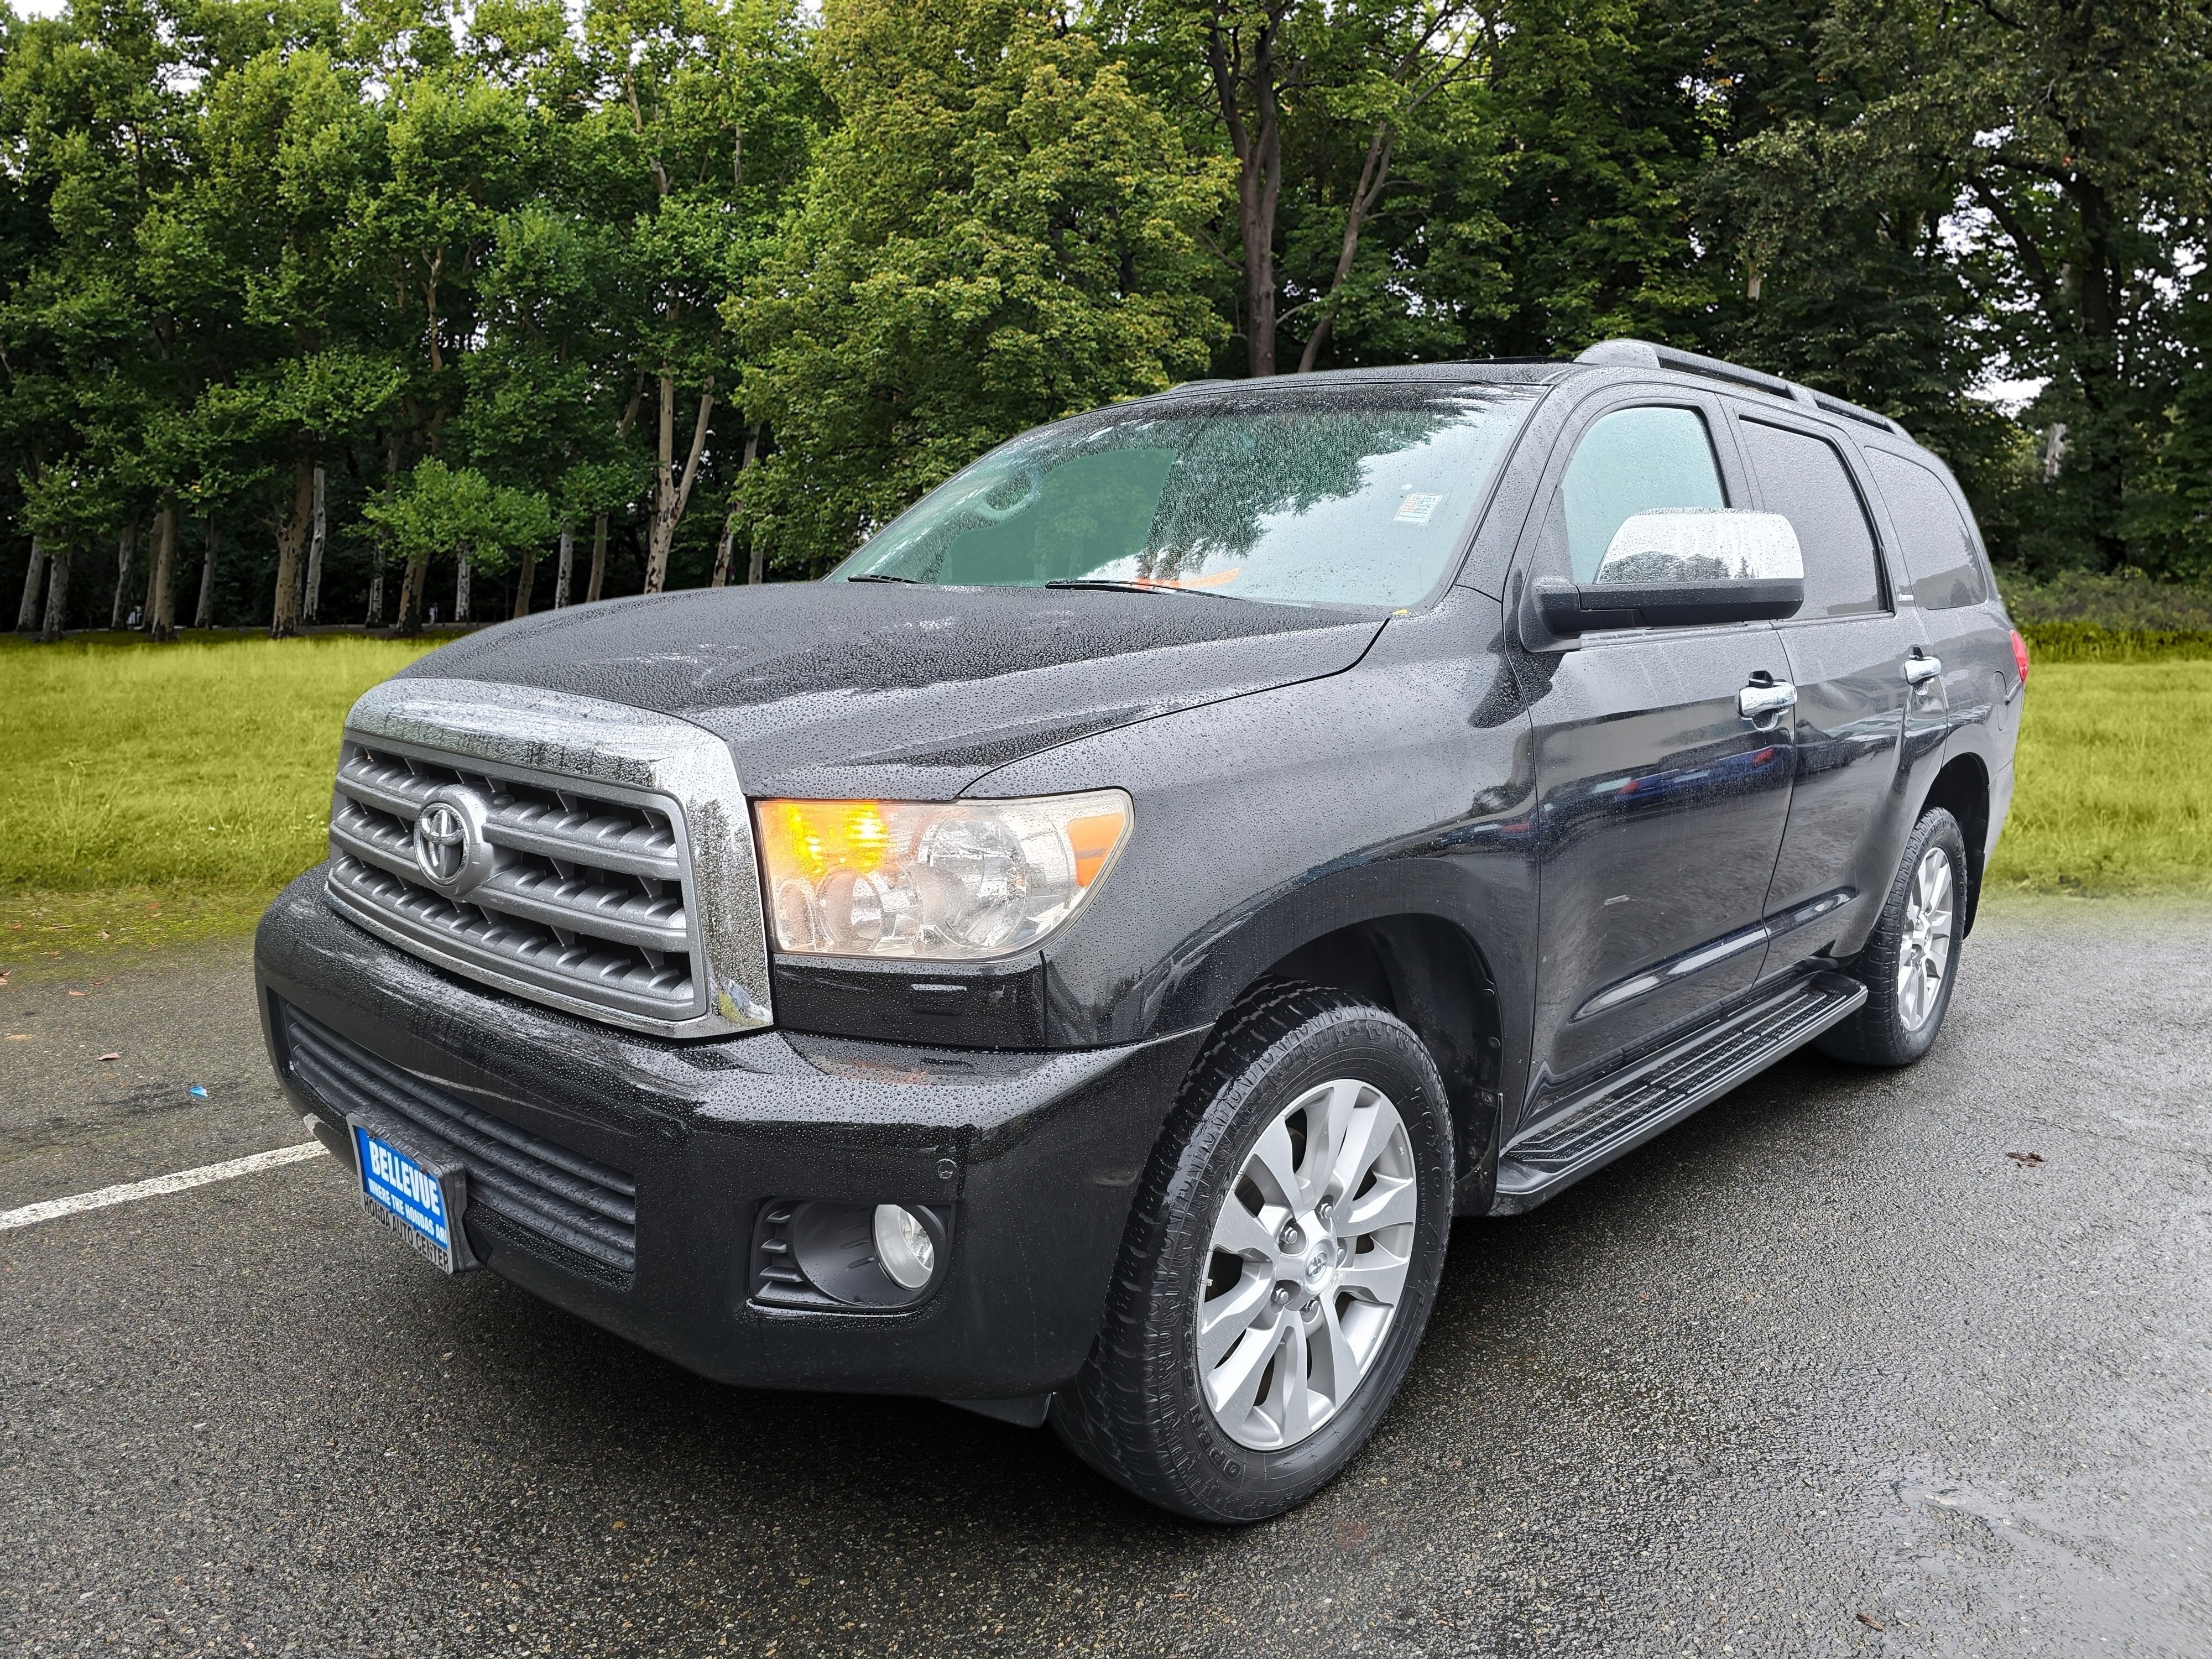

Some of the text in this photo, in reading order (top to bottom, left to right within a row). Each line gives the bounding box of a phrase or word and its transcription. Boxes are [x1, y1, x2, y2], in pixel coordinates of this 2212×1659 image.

[368, 1140, 440, 1215] BELLEVUE
[1410, 1086, 1444, 1197] TOYO
[363, 1193, 450, 1272] HONDA AUTO CENTER
[368, 1177, 392, 1207] WHERE
[390, 1193, 405, 1216] THE
[404, 1203, 435, 1236] HONDAS
